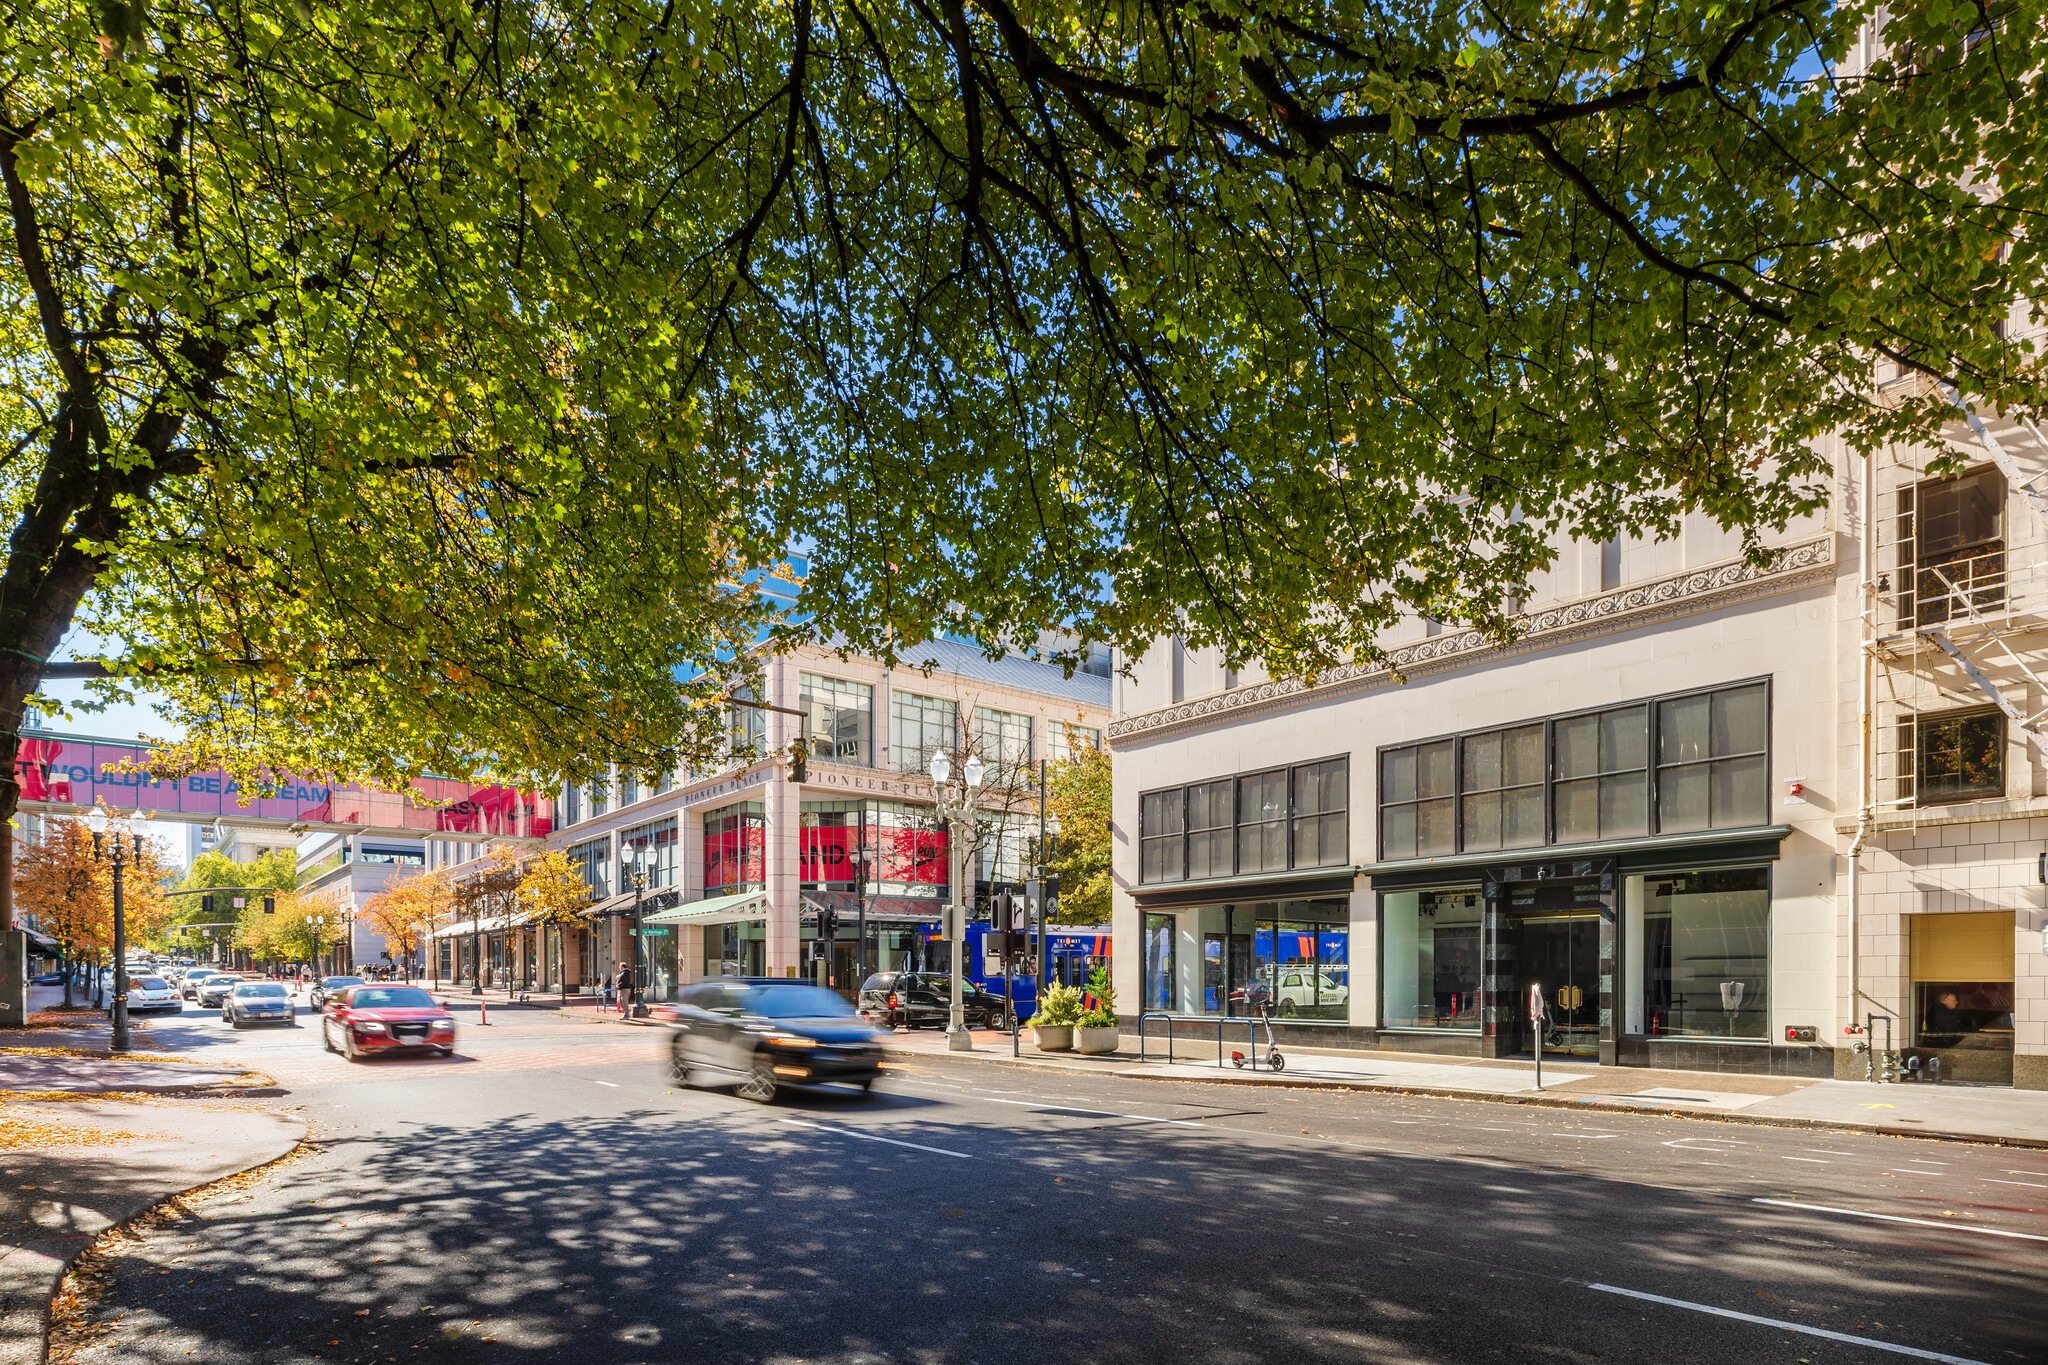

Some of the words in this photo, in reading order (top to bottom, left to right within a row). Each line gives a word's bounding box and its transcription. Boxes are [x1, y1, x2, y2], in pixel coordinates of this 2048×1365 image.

[16, 761, 34, 778] T
[188, 776, 221, 794] BE
[224, 779, 239, 795] A
[432, 800, 487, 816] ASY
[685, 784, 724, 804] PIONEER
[730, 772, 761, 790] PLACE
[805, 771, 890, 791] PIONEER
[903, 784, 955, 799] PLAE
